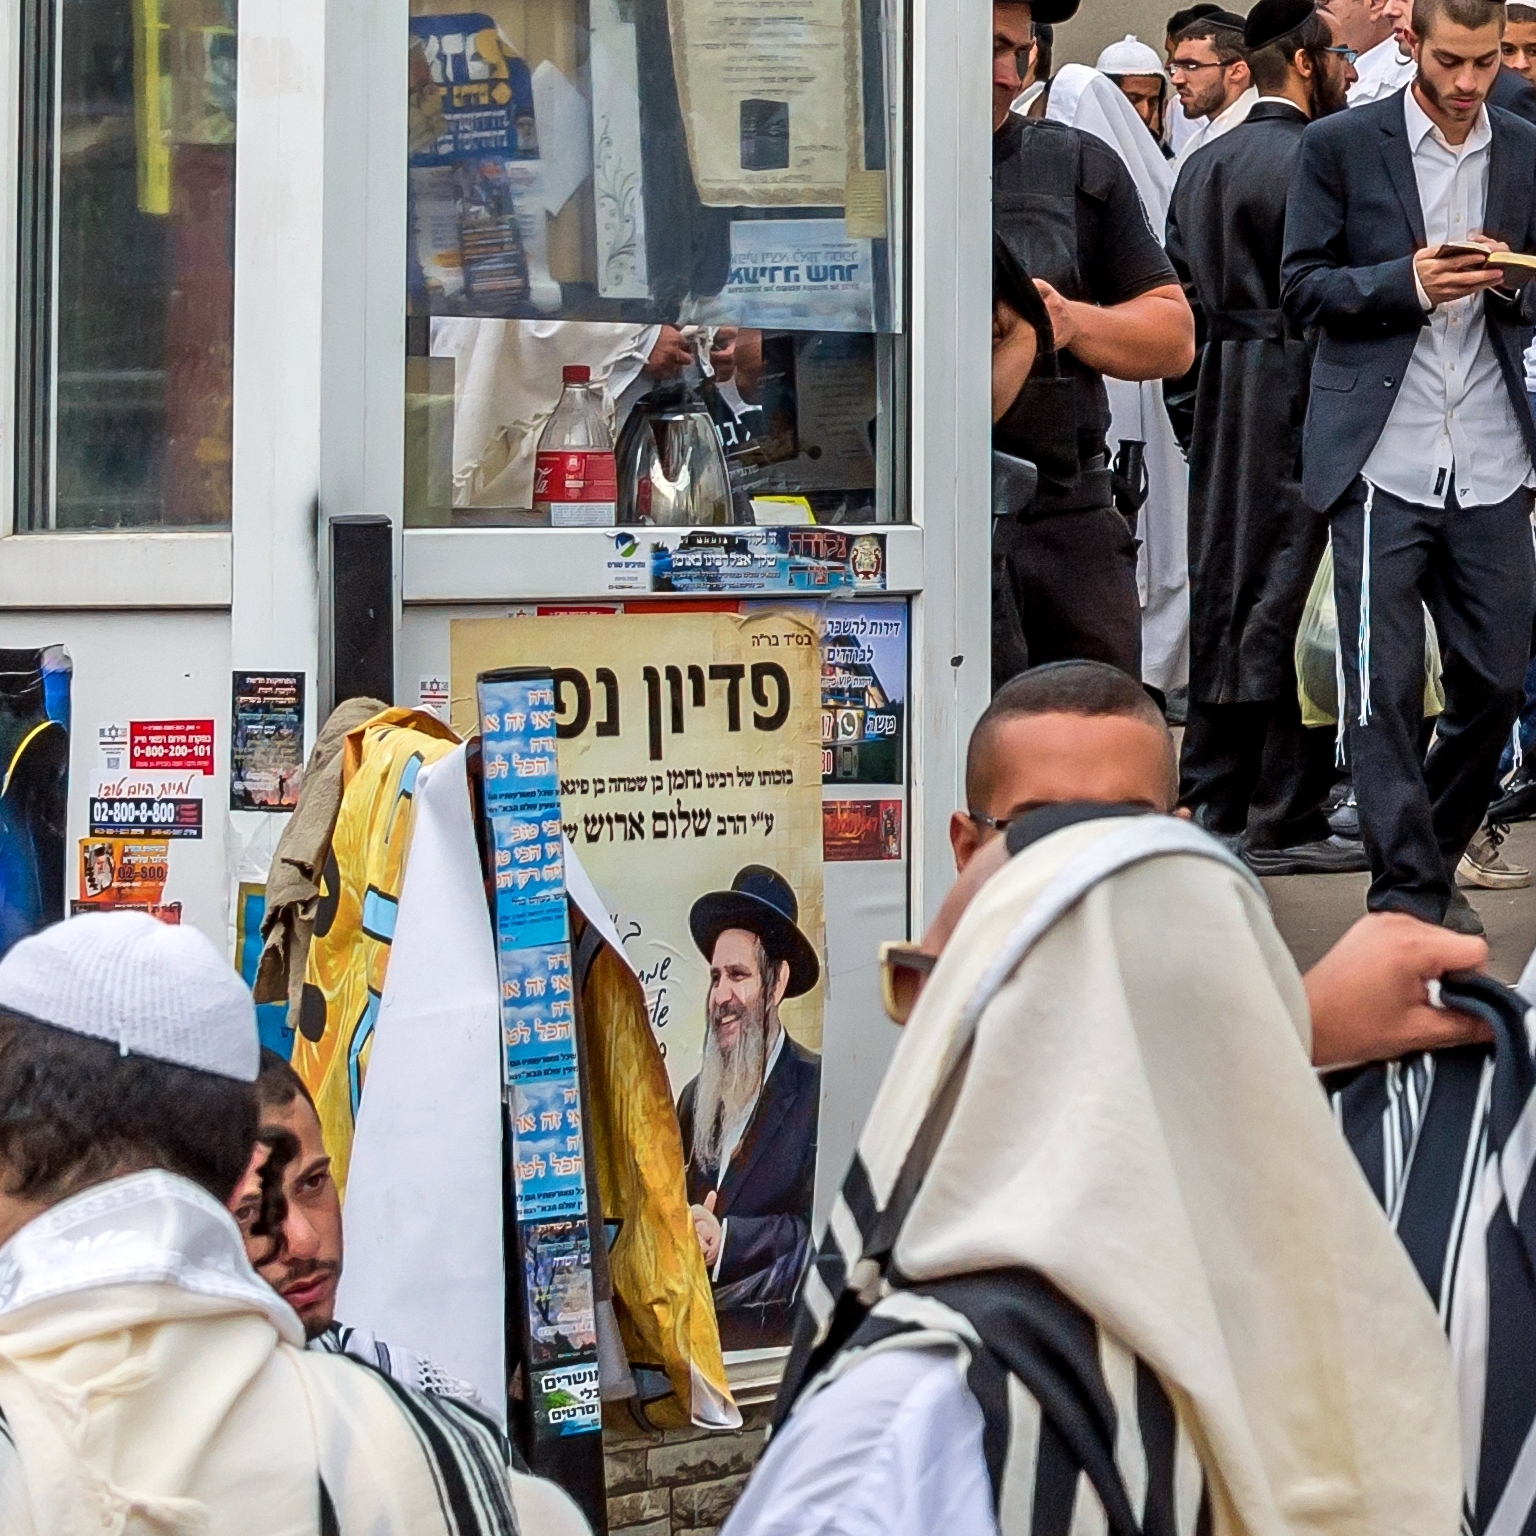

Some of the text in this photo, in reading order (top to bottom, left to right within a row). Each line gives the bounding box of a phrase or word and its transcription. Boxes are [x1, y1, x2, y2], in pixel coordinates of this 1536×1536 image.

[643, 662, 791, 761] פדיון
[608, 775, 648, 793] שמחה
[651, 775, 663, 794] בן
[666, 768, 703, 795] נחמן
[736, 765, 755, 786] של
[593, 777, 606, 798] בן
[583, 810, 645, 843] ארוש
[652, 798, 712, 840] שלום
[717, 814, 748, 837] הרב
